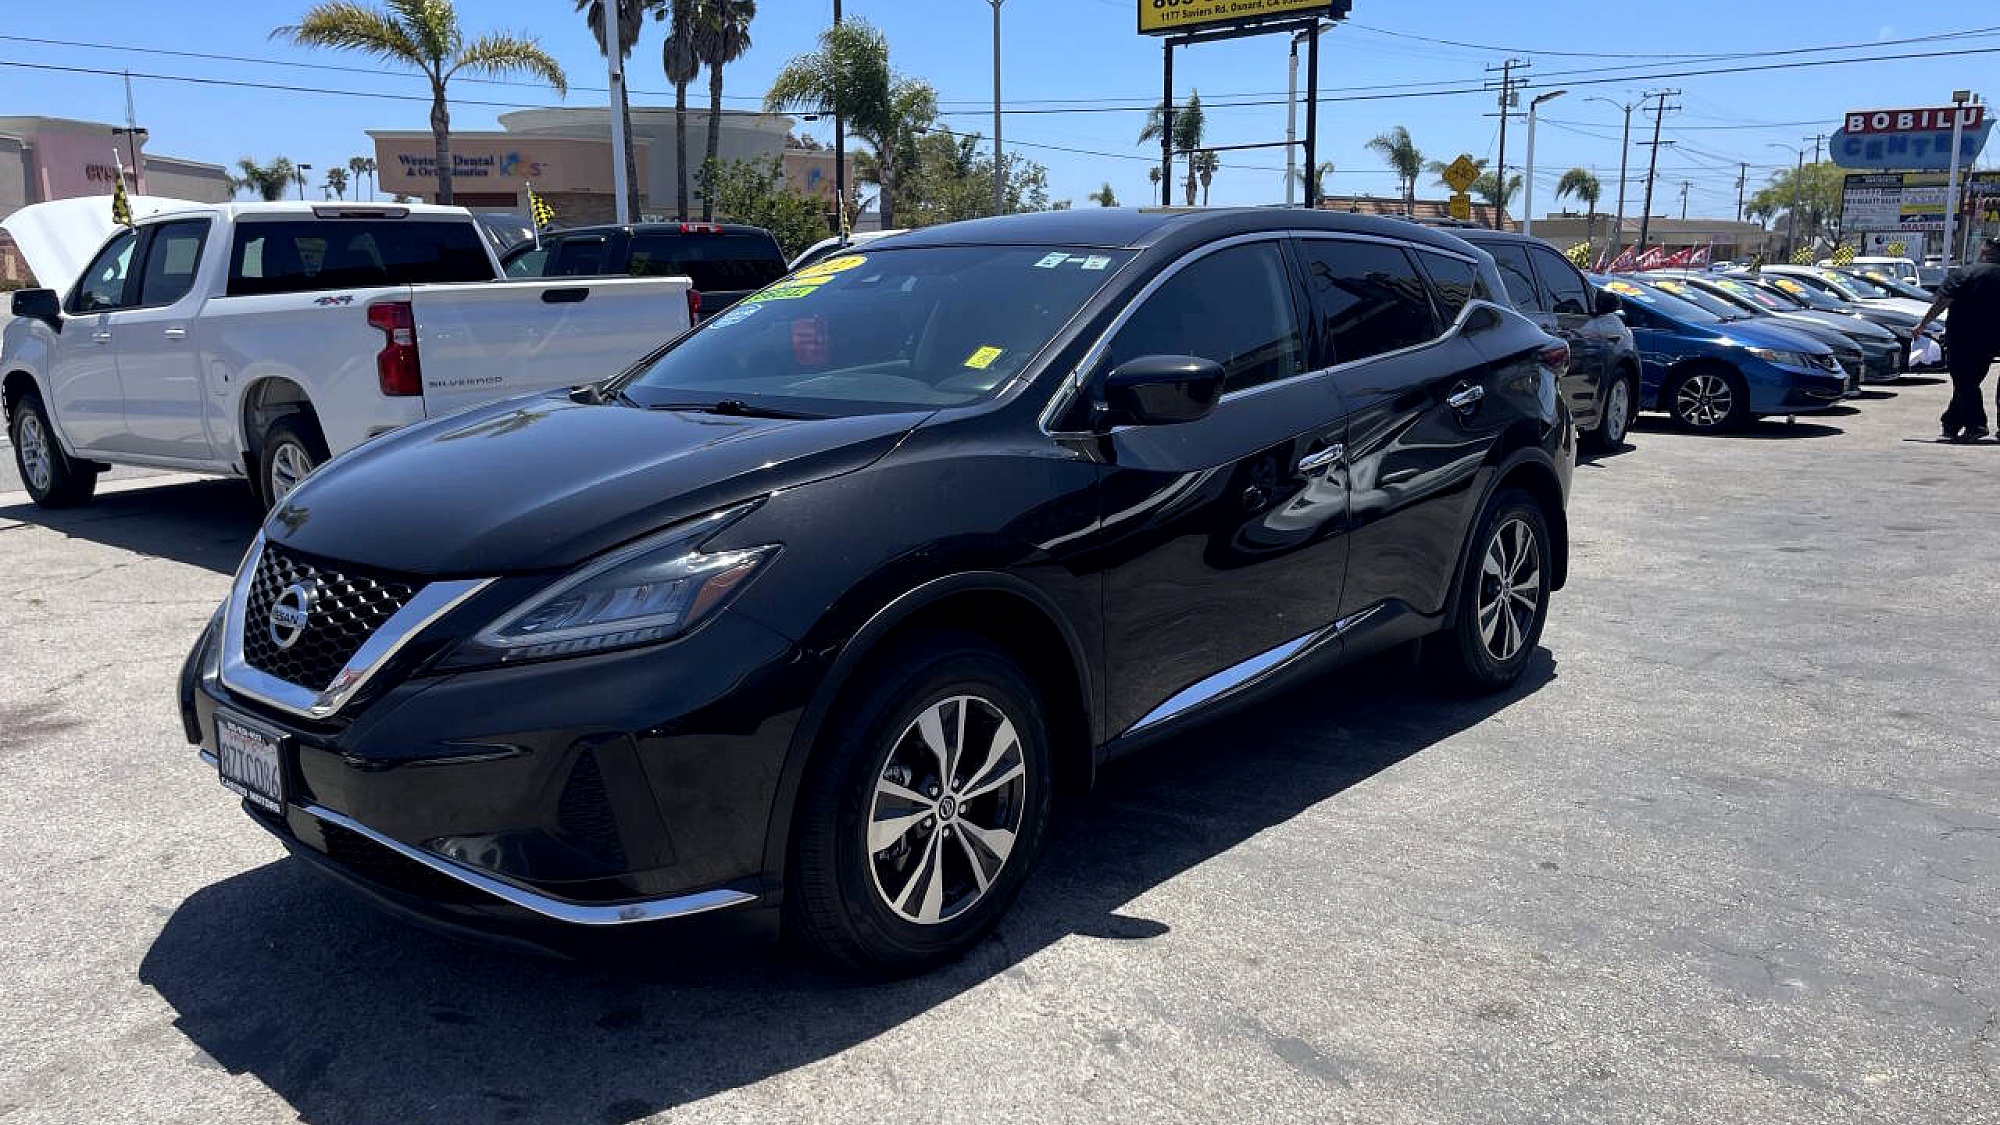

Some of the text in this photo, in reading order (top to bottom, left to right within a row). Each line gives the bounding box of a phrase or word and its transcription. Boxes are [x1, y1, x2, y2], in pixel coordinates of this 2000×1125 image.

[1215, 4, 1229, 13] Rd.
[1848, 109, 1977, 132] BOBILU
[397, 153, 494, 166] Weste Dental
[428, 376, 503, 388] SILVERADO
